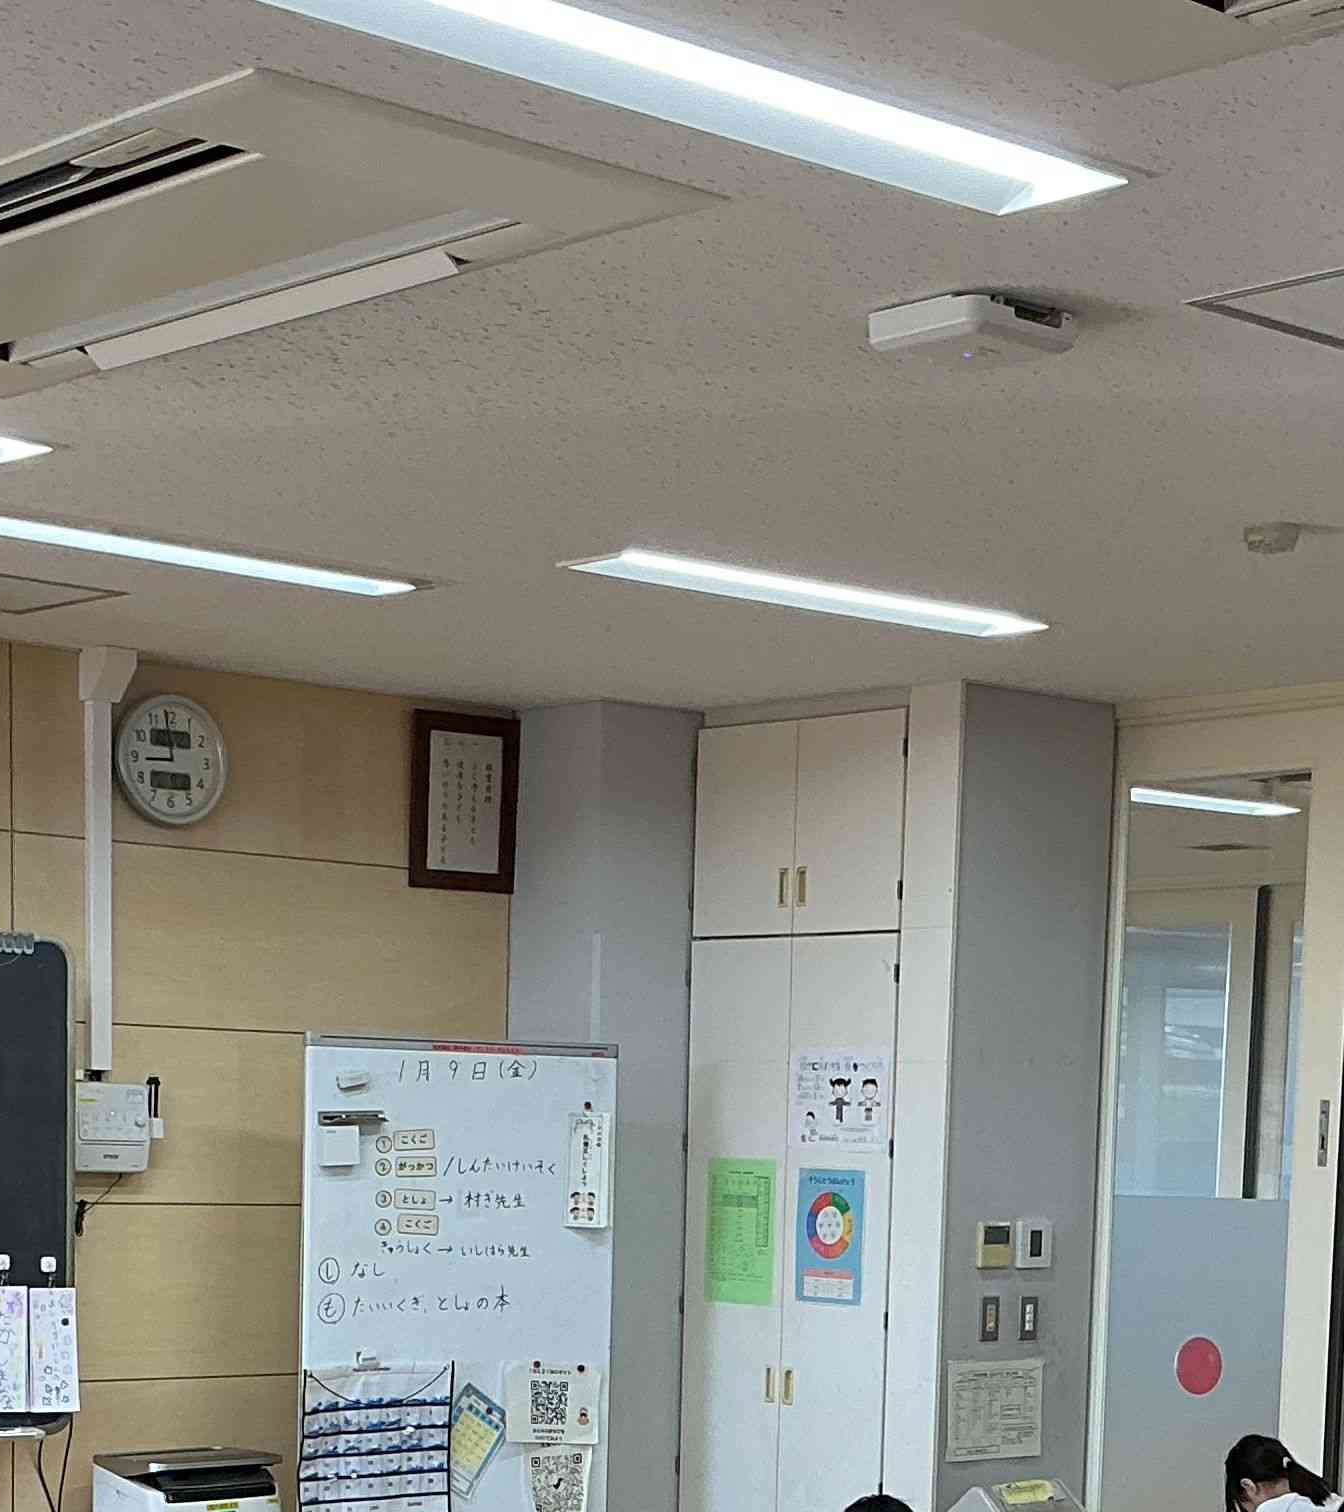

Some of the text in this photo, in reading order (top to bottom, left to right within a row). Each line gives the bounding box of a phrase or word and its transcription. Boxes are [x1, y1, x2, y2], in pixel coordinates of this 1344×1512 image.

[197, 735, 206, 749] 2
[130, 750, 139, 763] 9
[202, 758, 210, 771] 3
[136, 771, 146, 785] 8
[195, 778, 205, 790] 4
[149, 789, 158, 801] 7
[184, 792, 193, 806] 5
[165, 795, 176, 809] 6
[401, 1133, 428, 1145] こくご
[402, 1193, 428, 1205] としょ
[404, 1218, 433, 1231] こくご
[351, 1261, 386, 1278] なし
